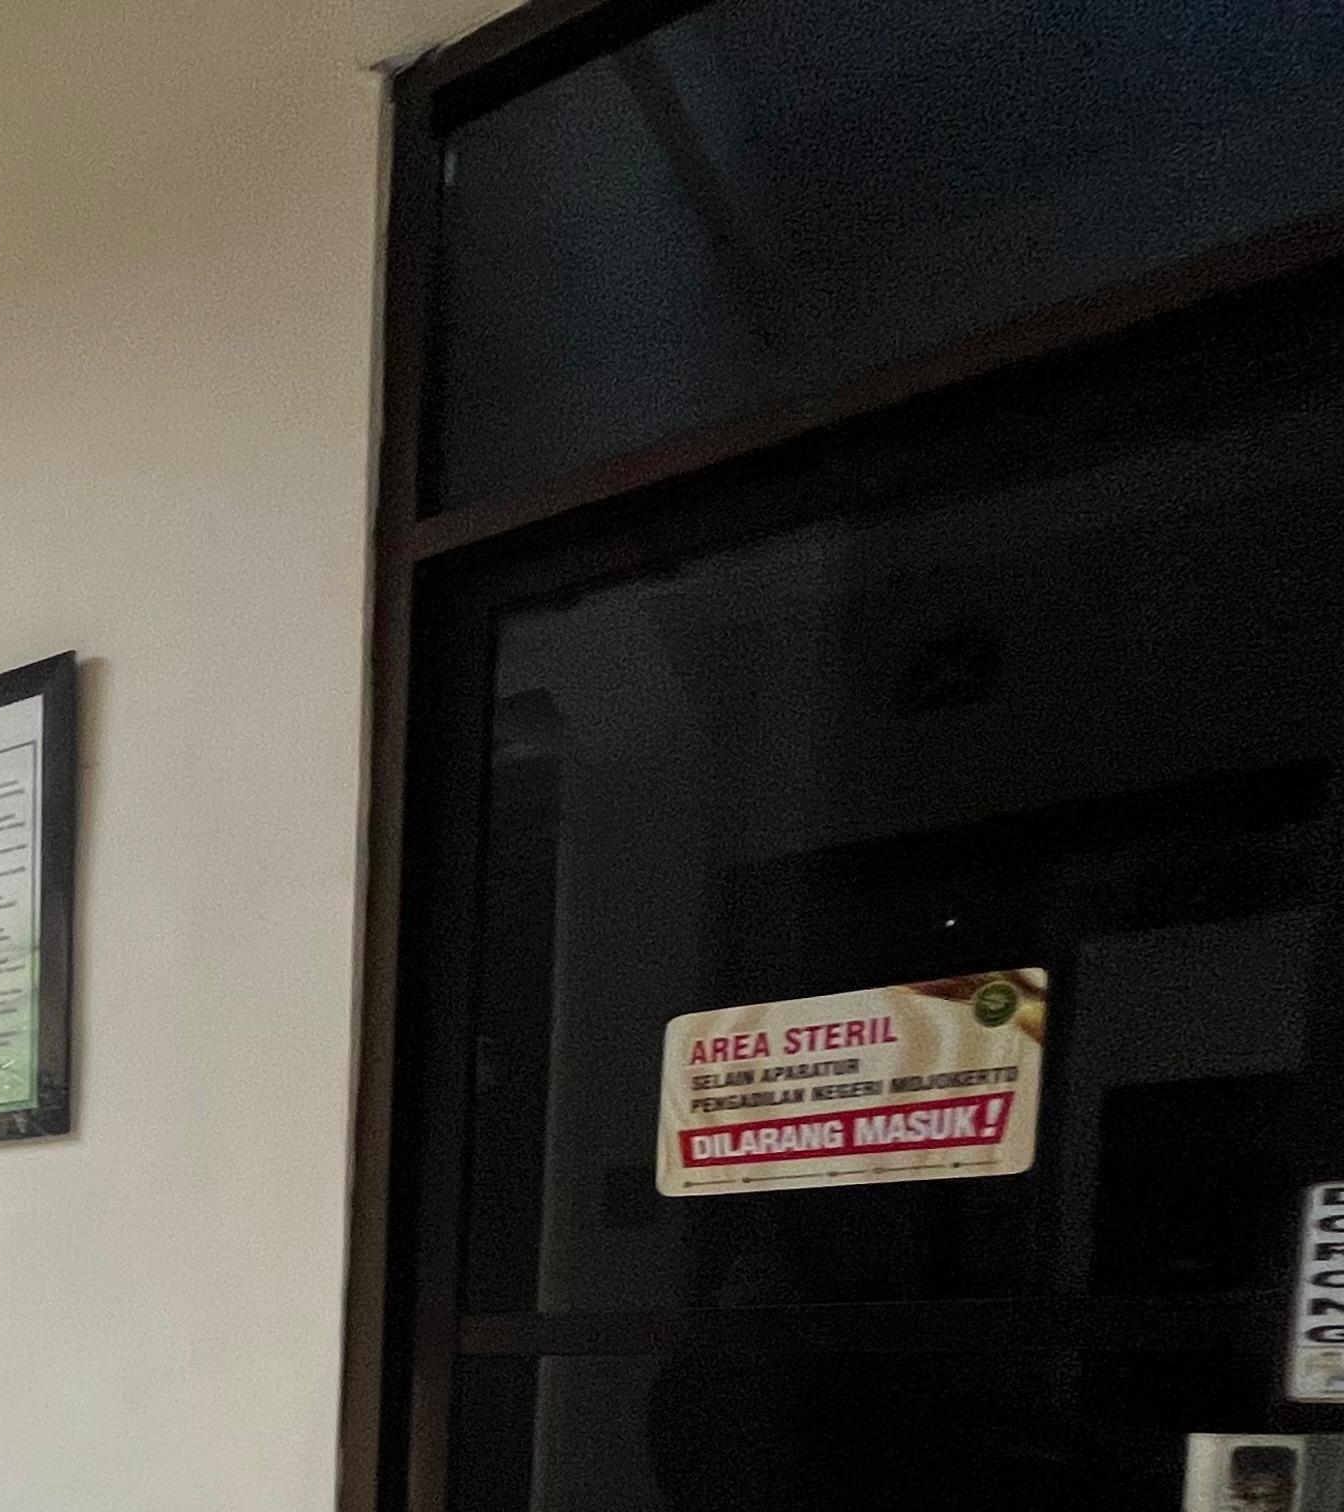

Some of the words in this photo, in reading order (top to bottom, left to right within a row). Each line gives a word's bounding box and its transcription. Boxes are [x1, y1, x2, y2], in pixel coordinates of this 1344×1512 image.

[689, 1032, 770, 1066] AREA
[783, 1016, 898, 1056] STERIL
[690, 1069, 755, 1092] SELAIN
[760, 1058, 860, 1084] APARATUR
[690, 1088, 805, 1113] PENGADILAN
[691, 1119, 844, 1160] DILARANG
